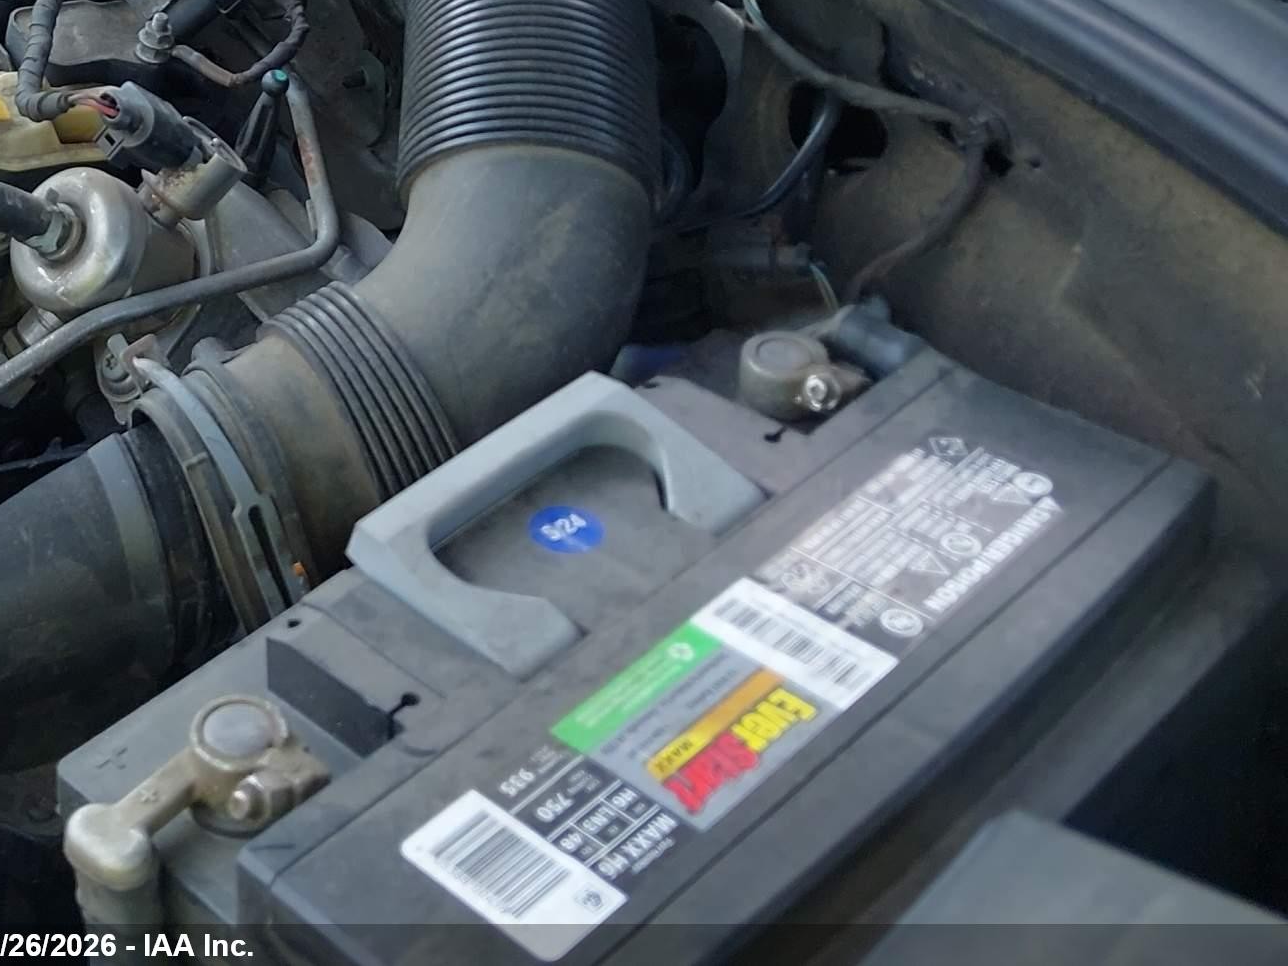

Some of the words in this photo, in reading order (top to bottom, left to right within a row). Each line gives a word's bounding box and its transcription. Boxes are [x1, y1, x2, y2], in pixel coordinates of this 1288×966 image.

[654, 738, 694, 774] MAXX
[536, 792, 573, 822] 750
[582, 804, 617, 832] LN3
[620, 812, 679, 858] MAXX
